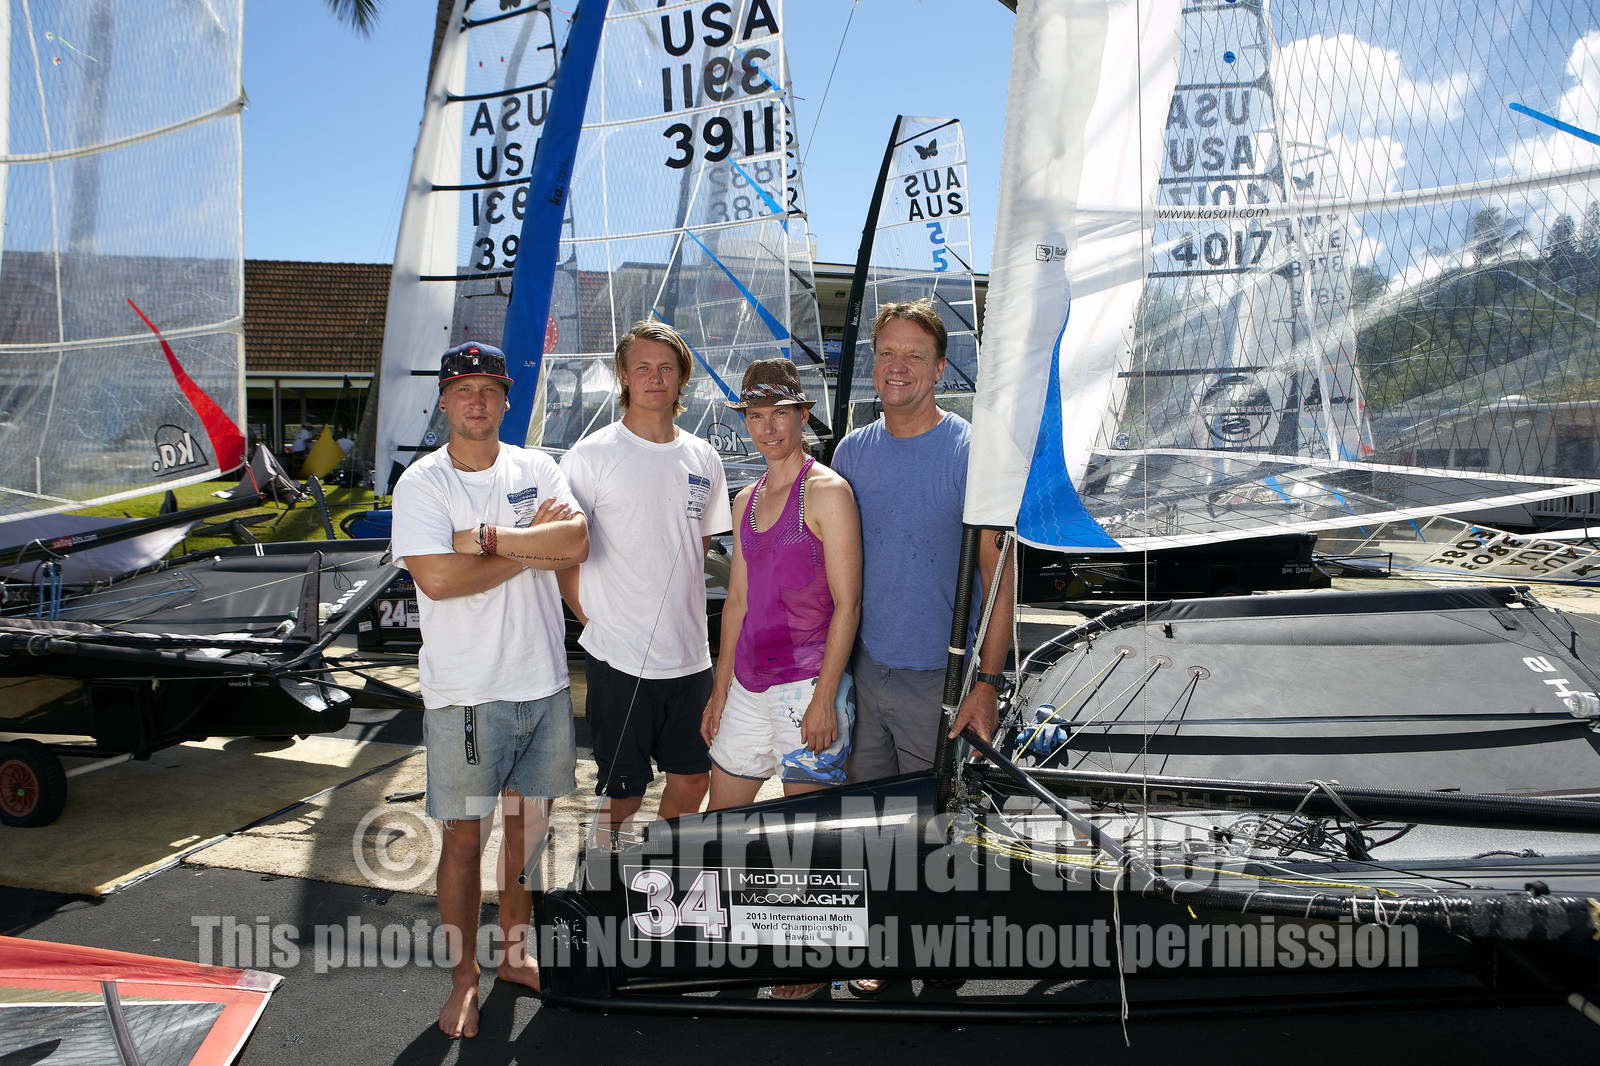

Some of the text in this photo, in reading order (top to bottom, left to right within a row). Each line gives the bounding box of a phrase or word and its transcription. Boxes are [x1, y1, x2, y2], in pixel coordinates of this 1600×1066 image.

[661, 0, 779, 56] USA
[663, 106, 775, 169] 3911
[476, 138, 542, 180] US
[1169, 135, 1254, 173] USA
[909, 192, 963, 221] AUS
[1158, 206, 1270, 220] www.kasail.com
[932, 248, 949, 272] 5
[1171, 230, 1273, 267] 4017
[379, 600, 408, 627] 24
[739, 873, 860, 886] McDOUGALL
[631, 869, 729, 939] 34
[740, 892, 860, 905] McCONAGHY
[746, 912, 853, 922] 2013 International Moth
[751, 922, 848, 933] World Championship
[784, 932, 815, 941] Hawaii
